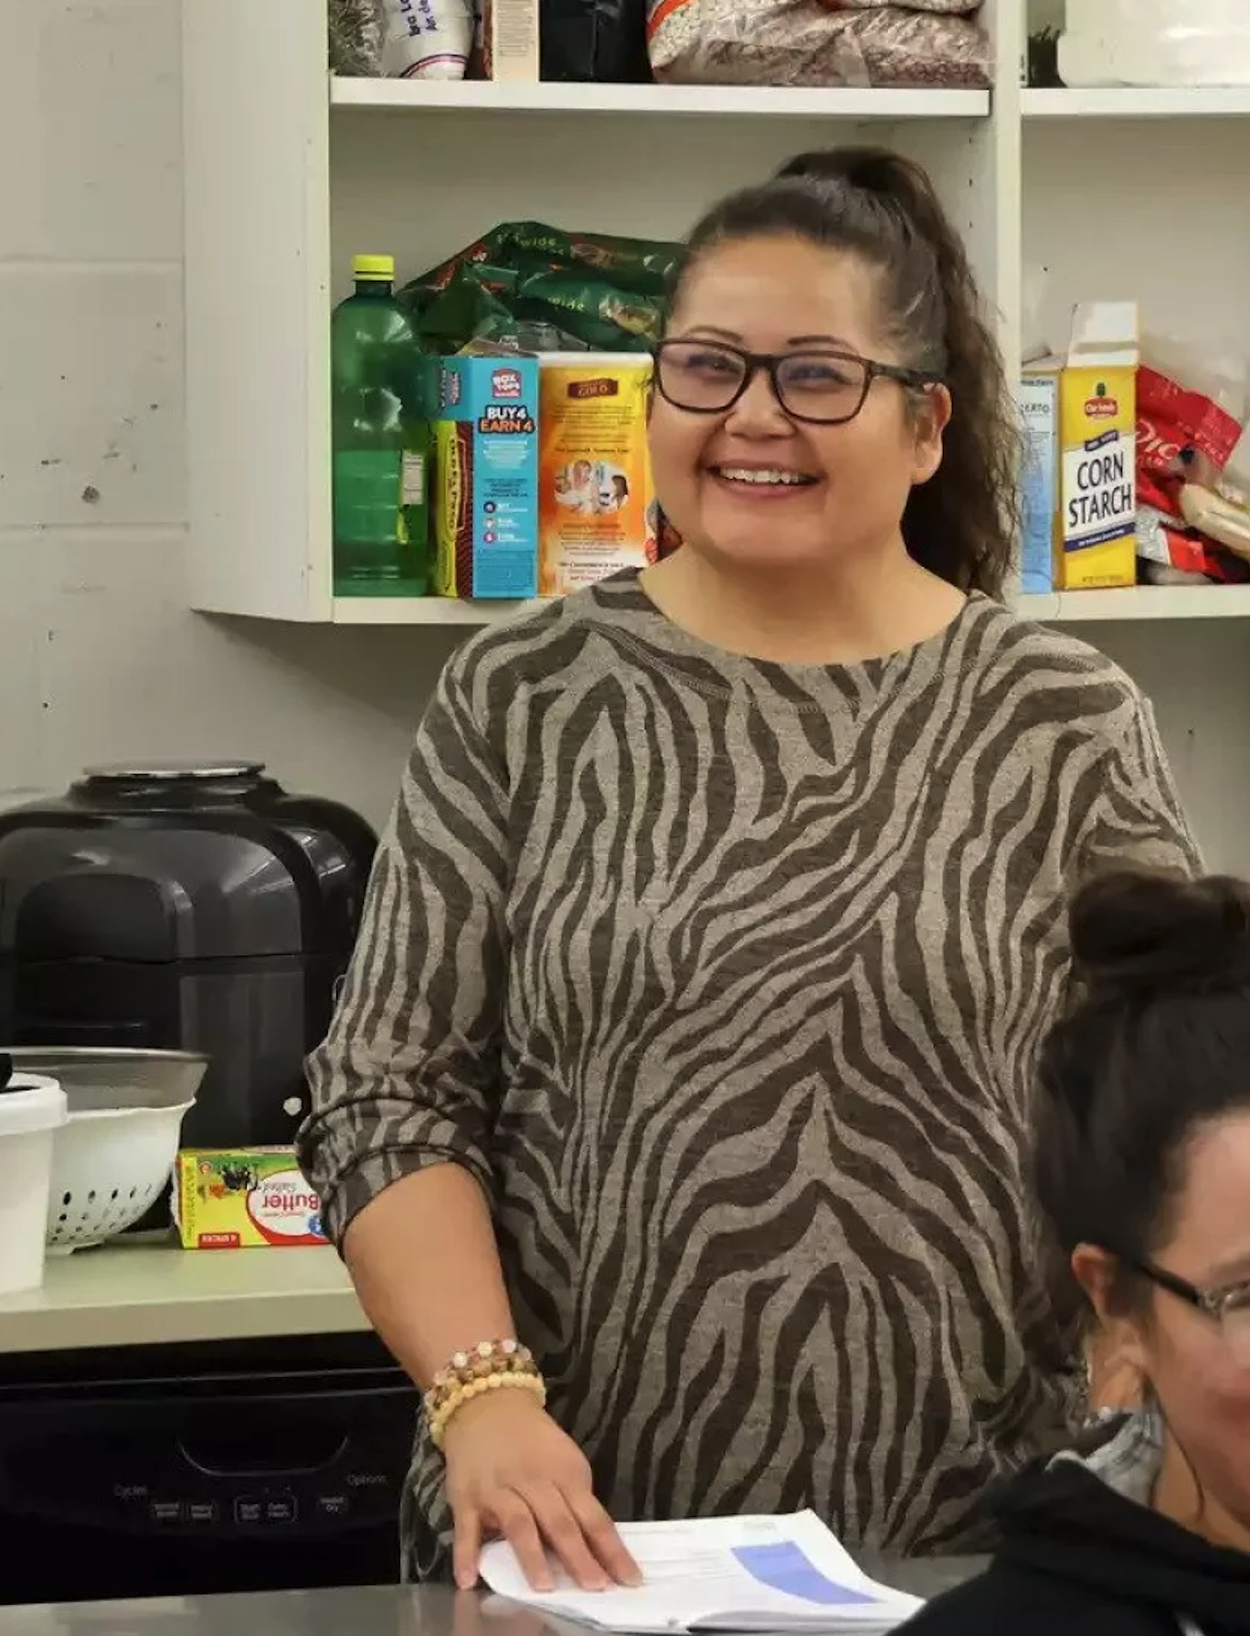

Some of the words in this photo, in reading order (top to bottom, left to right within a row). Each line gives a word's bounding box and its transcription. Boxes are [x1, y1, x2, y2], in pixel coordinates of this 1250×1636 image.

[481, 419, 520, 432] EARN
[1078, 452, 1124, 490] CORN
[1069, 484, 1132, 528] STARCH
[262, 1193, 319, 1211] Butter
